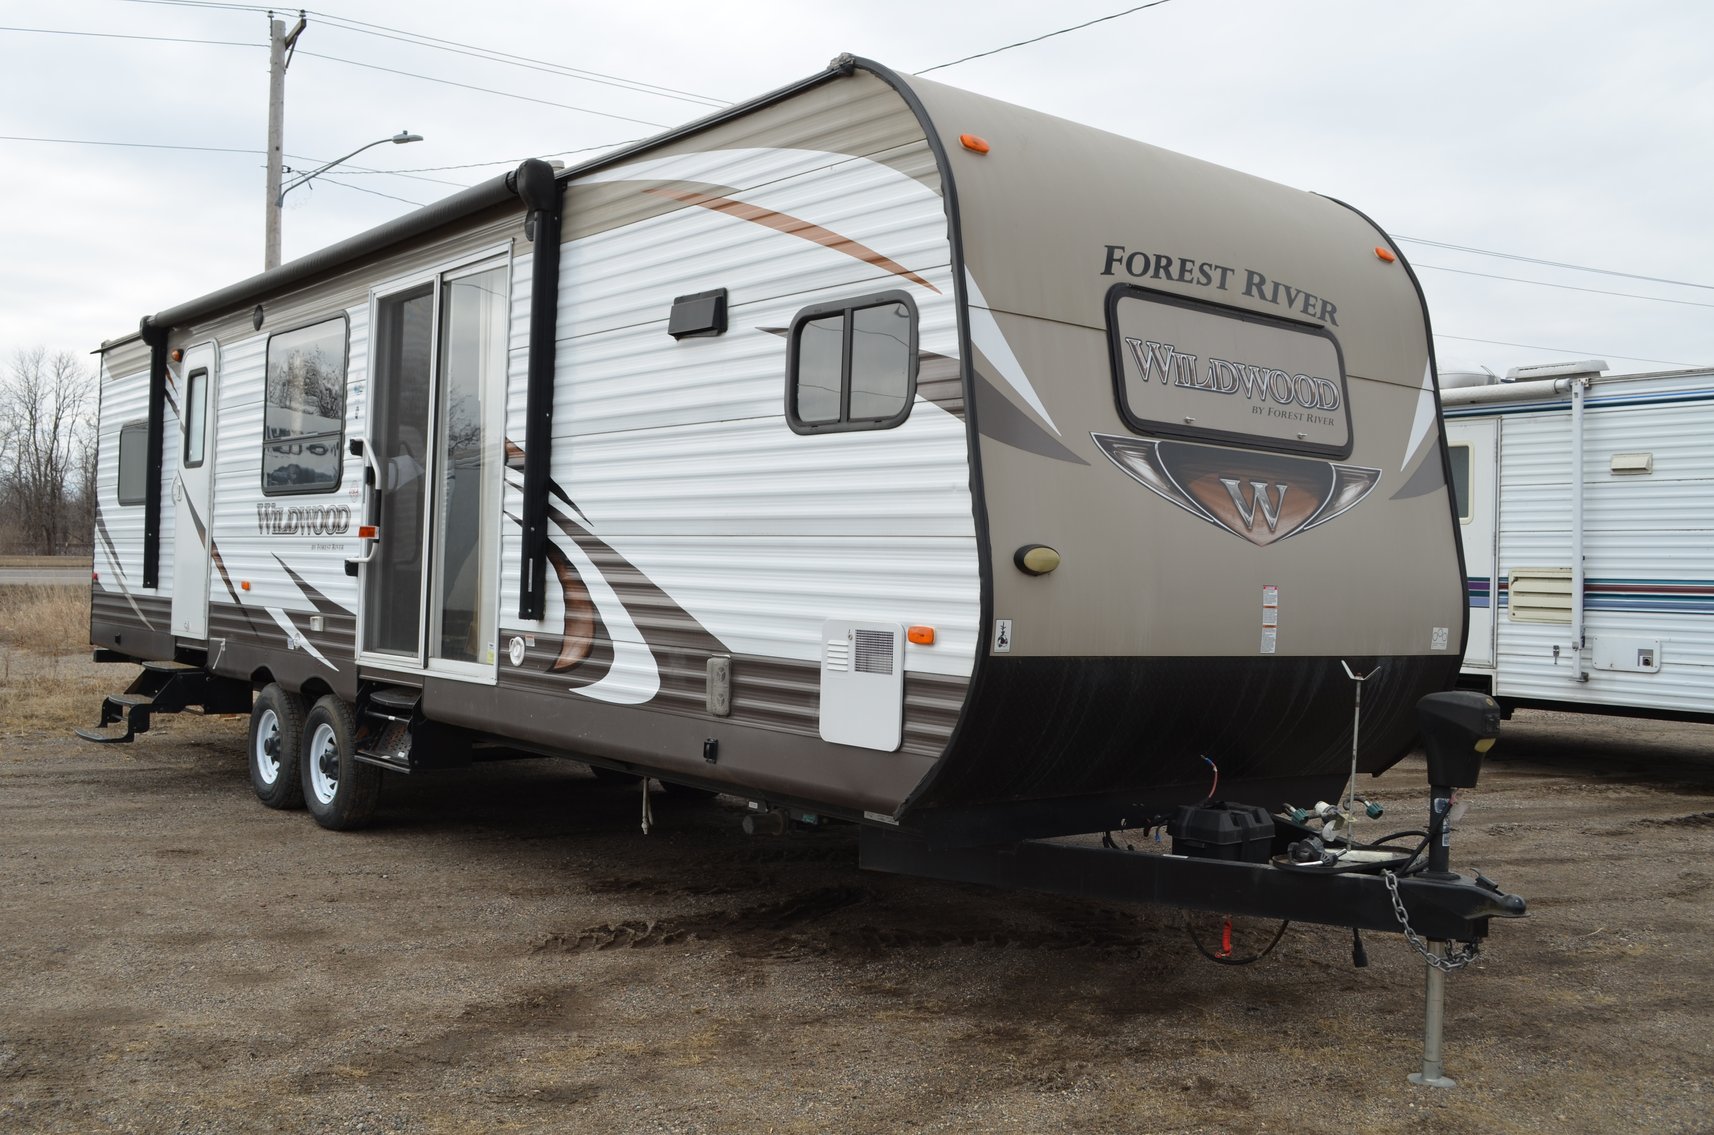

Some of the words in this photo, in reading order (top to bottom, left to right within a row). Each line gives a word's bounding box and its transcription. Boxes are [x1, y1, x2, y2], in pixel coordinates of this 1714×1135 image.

[1100, 245, 1235, 290] FOREST
[1241, 268, 1340, 327] RIVER
[1125, 337, 1340, 411] WILDWOOD
[1252, 405, 1265, 415] BY
[1268, 406, 1304, 422] FOREST
[1306, 413, 1335, 426] RIVER
[257, 502, 351, 536] WILDWOOD
[1219, 478, 1287, 532] W
